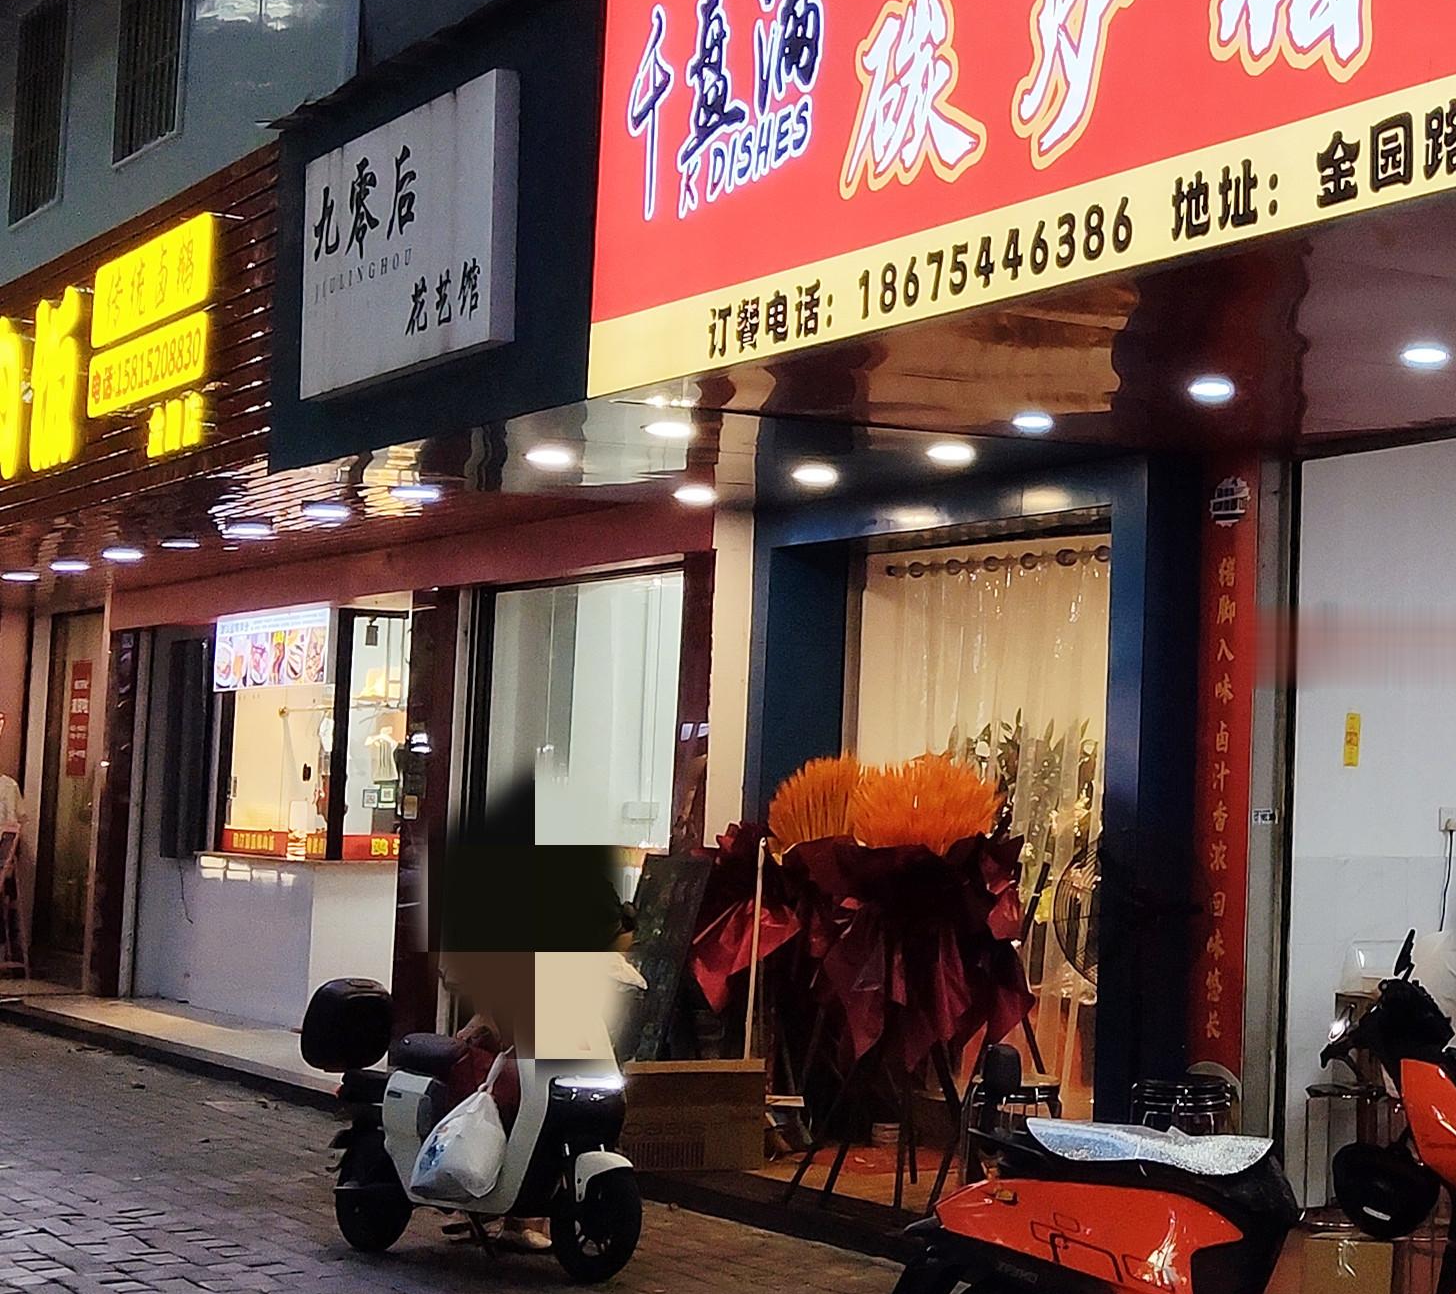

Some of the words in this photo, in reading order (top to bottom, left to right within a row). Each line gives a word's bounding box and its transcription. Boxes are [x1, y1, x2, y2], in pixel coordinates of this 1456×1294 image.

[706, 95, 812, 202] DISHES
[313, 145, 417, 262] 九零后
[314, 247, 413, 305] JIULINGHOU
[404, 257, 481, 336] 花艺馆
